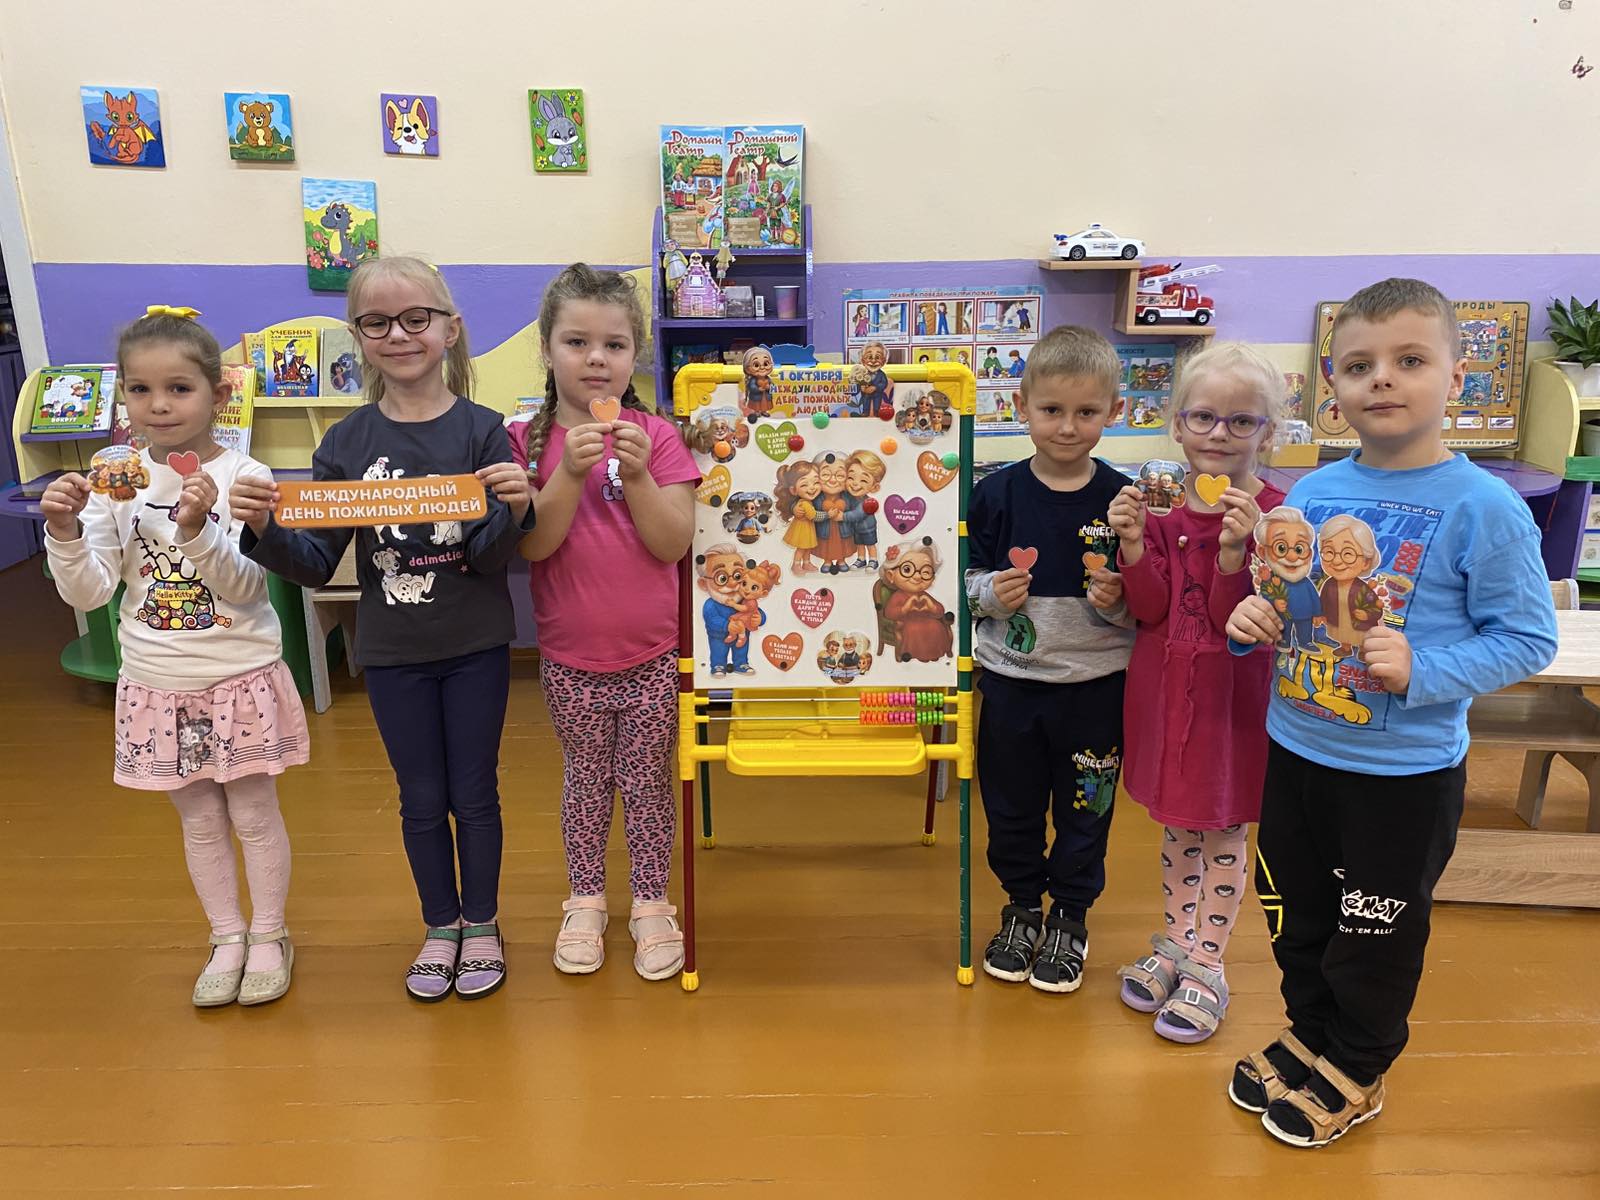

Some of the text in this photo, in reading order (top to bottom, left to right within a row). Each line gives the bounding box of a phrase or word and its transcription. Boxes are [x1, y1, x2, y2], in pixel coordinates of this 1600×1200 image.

[671, 130, 722, 145] Домашн
[733, 131, 798, 145] Домашний
[665, 142, 704, 157] Театр
[727, 142, 765, 157] Театр
[1454, 301, 1496, 310] ИРОДЫ
[778, 370, 843, 381] 1 ОКТЯБРЯ
[769, 383, 859, 395] МЕЖДУНАРОДНЫЙ
[775, 395, 852, 405] ДЕНЬ ПОЖИЛЫХ
[796, 405, 830, 415] ЛЮДЕЙ
[299, 481, 457, 503] МЕЖДУНАРОДНЫЙ
[602, 484, 624, 501] LO
[281, 497, 481, 521] ДЕНЬ ПОЖИЛЫХ ЛЮДЕЙ
[1081, 525, 1116, 537] MINECR
[408, 551, 464, 567] dalmatia
[156, 590, 193, 599] Hello Kitty
[1072, 752, 1120, 769] MINECRAFT
